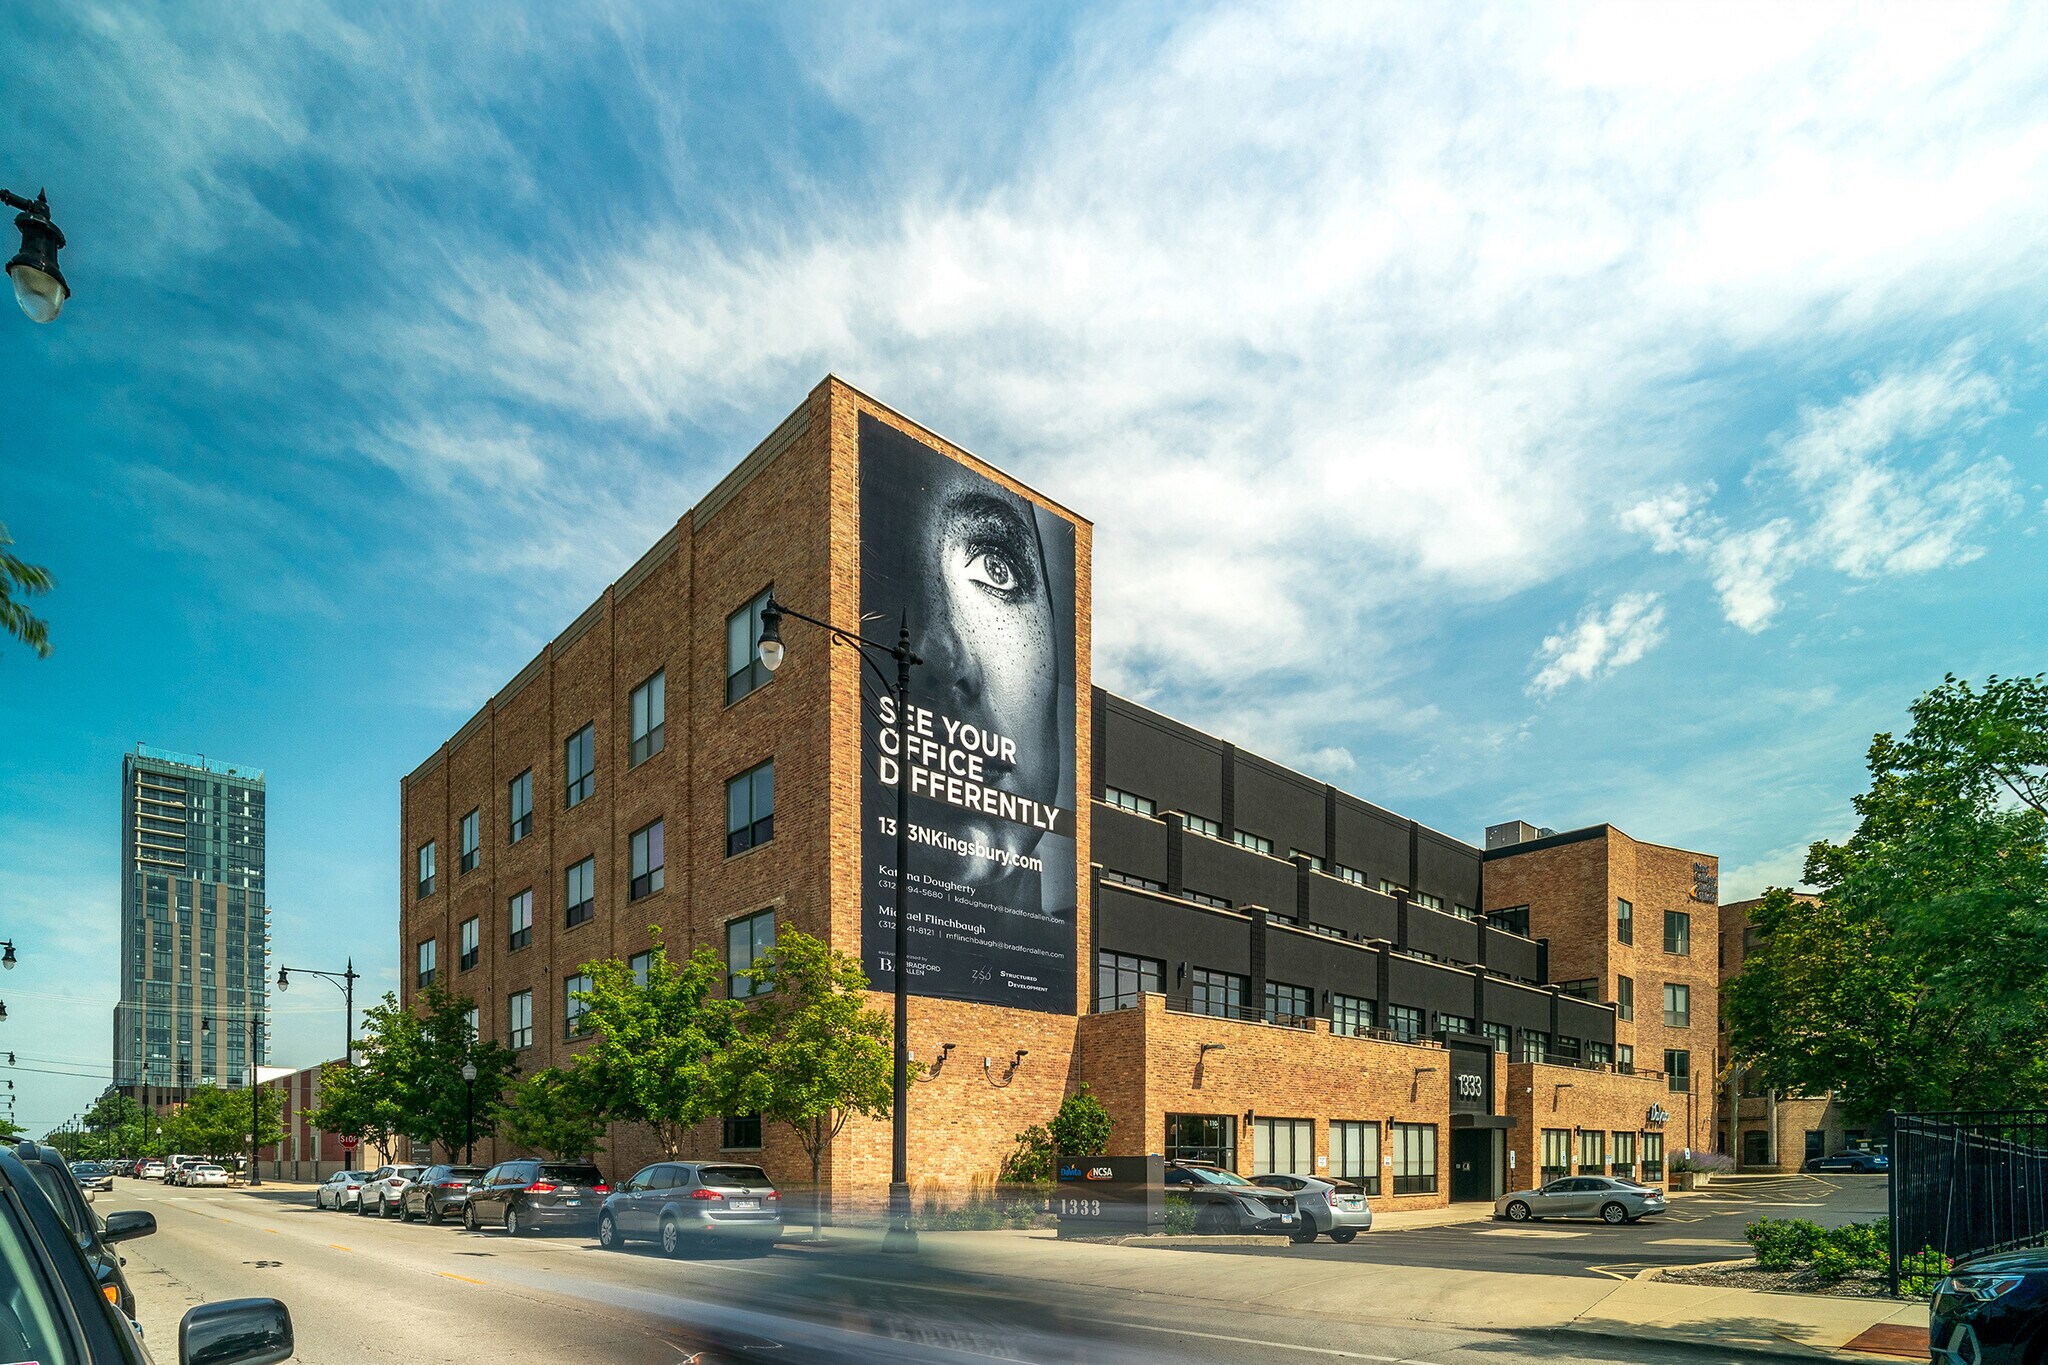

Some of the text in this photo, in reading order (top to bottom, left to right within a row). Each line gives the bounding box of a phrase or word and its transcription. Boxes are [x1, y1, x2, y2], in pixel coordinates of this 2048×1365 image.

[879, 696, 1017, 765] SEE YOUR
[879, 727, 984, 783] OFFICE
[880, 757, 1060, 831] DFFERENTLY
[878, 816, 1043, 872] 133NKingsbury.com
[879, 864, 976, 896] Katna Dougherty
[878, 880, 1065, 925] (312 94-5680 kdougherty@bradfordallen.com
[878, 905, 986, 934] Micael Flinchbaugh
[878, 920, 1065, 959] (312 41-8121 mflinchbaugh@bradfordallen.com
[1458, 1074, 1482, 1097] 1333
[340, 1135, 358, 1143] STOP
[1092, 1167, 1113, 1176] NCSA
[1061, 1199, 1100, 1216] 1333
